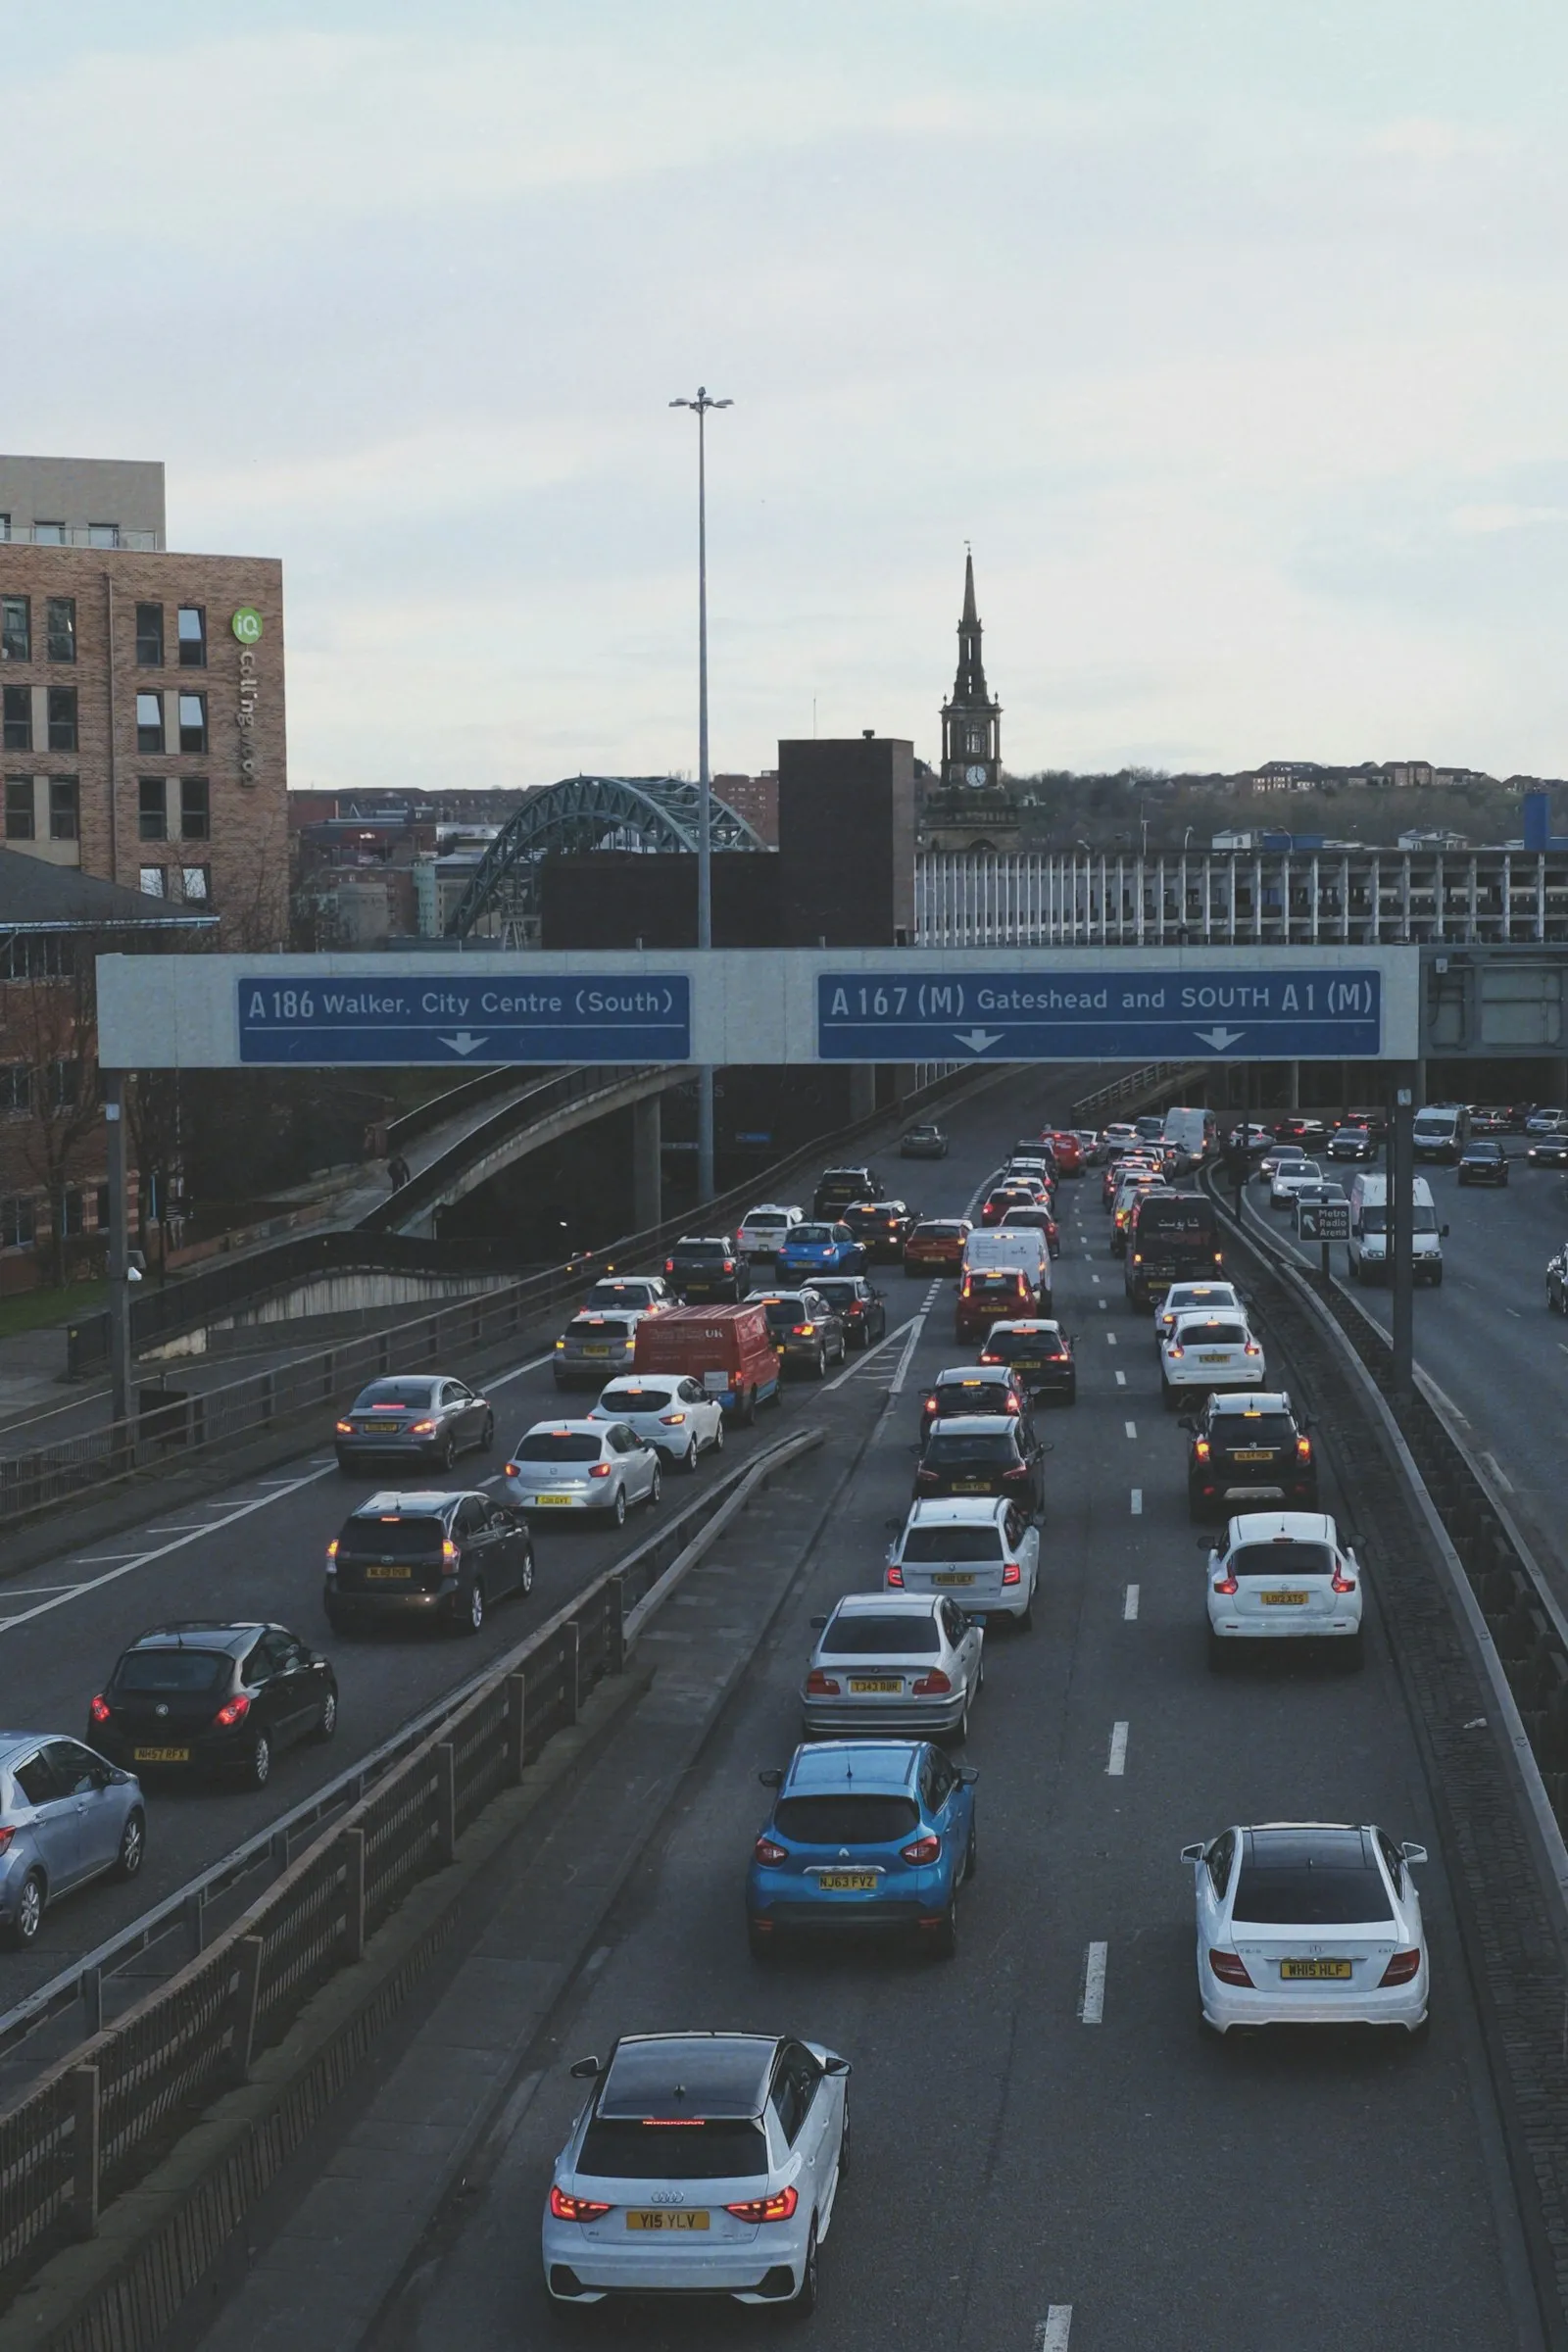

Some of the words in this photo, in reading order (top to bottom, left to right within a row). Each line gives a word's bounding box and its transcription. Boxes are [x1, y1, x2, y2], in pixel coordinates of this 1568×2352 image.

[237, 615, 259, 636] iQ
[421, 993, 469, 1016] City
[481, 992, 562, 1012] Centre
[575, 989, 672, 1013] (South)
[977, 989, 1107, 1009] Gateshead
[1121, 989, 1164, 1008] and
[1181, 988, 1269, 1007] SOUTH
[1319, 1228, 1347, 1237] Arena
[705, 1329, 723, 1338] UK
[138, 1748, 164, 1759] NH57
[166, 1748, 184, 1759] RFX
[820, 1876, 849, 1886] NJ63
[852, 1875, 874, 1886] FVZ
[1289, 1964, 1316, 1977] WH15
[1319, 1964, 1343, 1976] HLF
[640, 2214, 662, 2229] Y15
[667, 2214, 696, 2229] YLV
